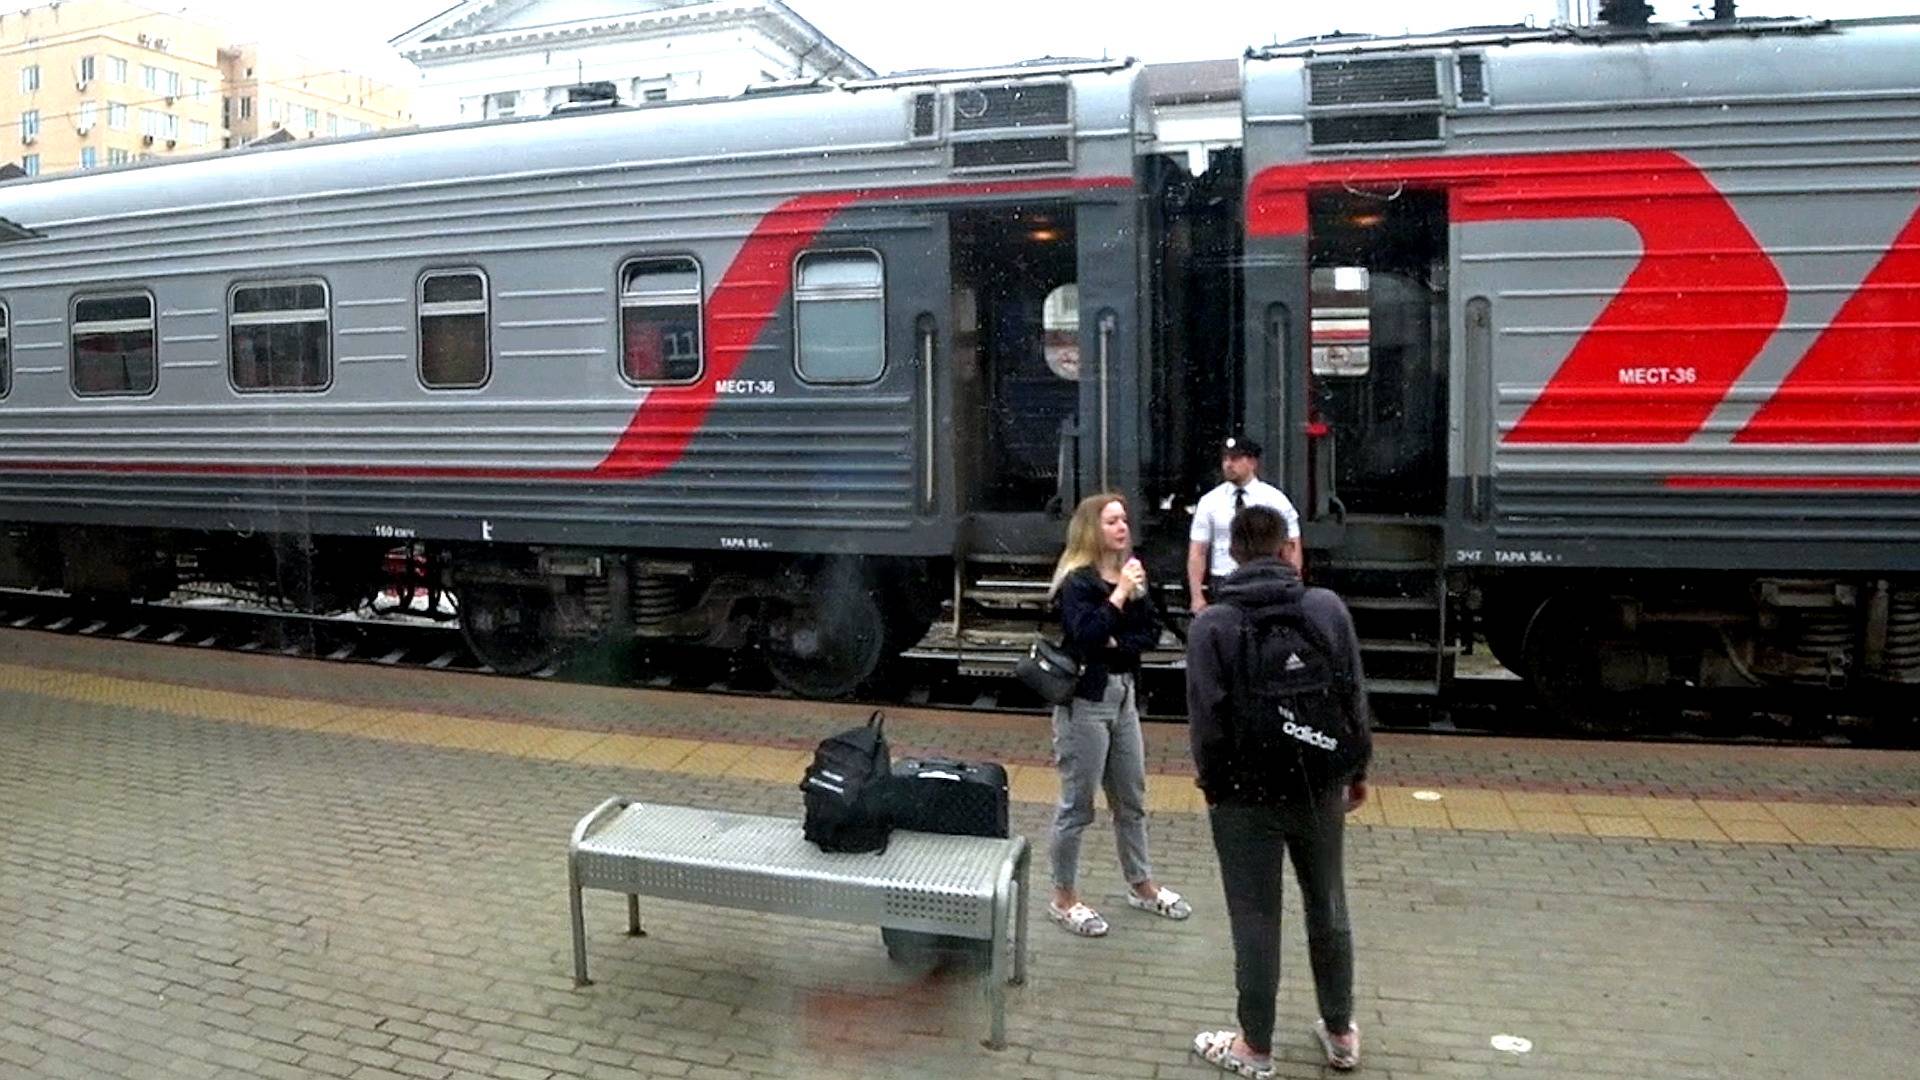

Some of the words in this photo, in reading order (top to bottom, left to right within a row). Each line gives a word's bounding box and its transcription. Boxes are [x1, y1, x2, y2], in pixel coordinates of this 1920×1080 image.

[664, 331, 698, 360] 11
[715, 379, 776, 394] МЕСТ-36
[1618, 366, 1697, 384] МЕСТ-36
[1282, 721, 1338, 751] adidas
